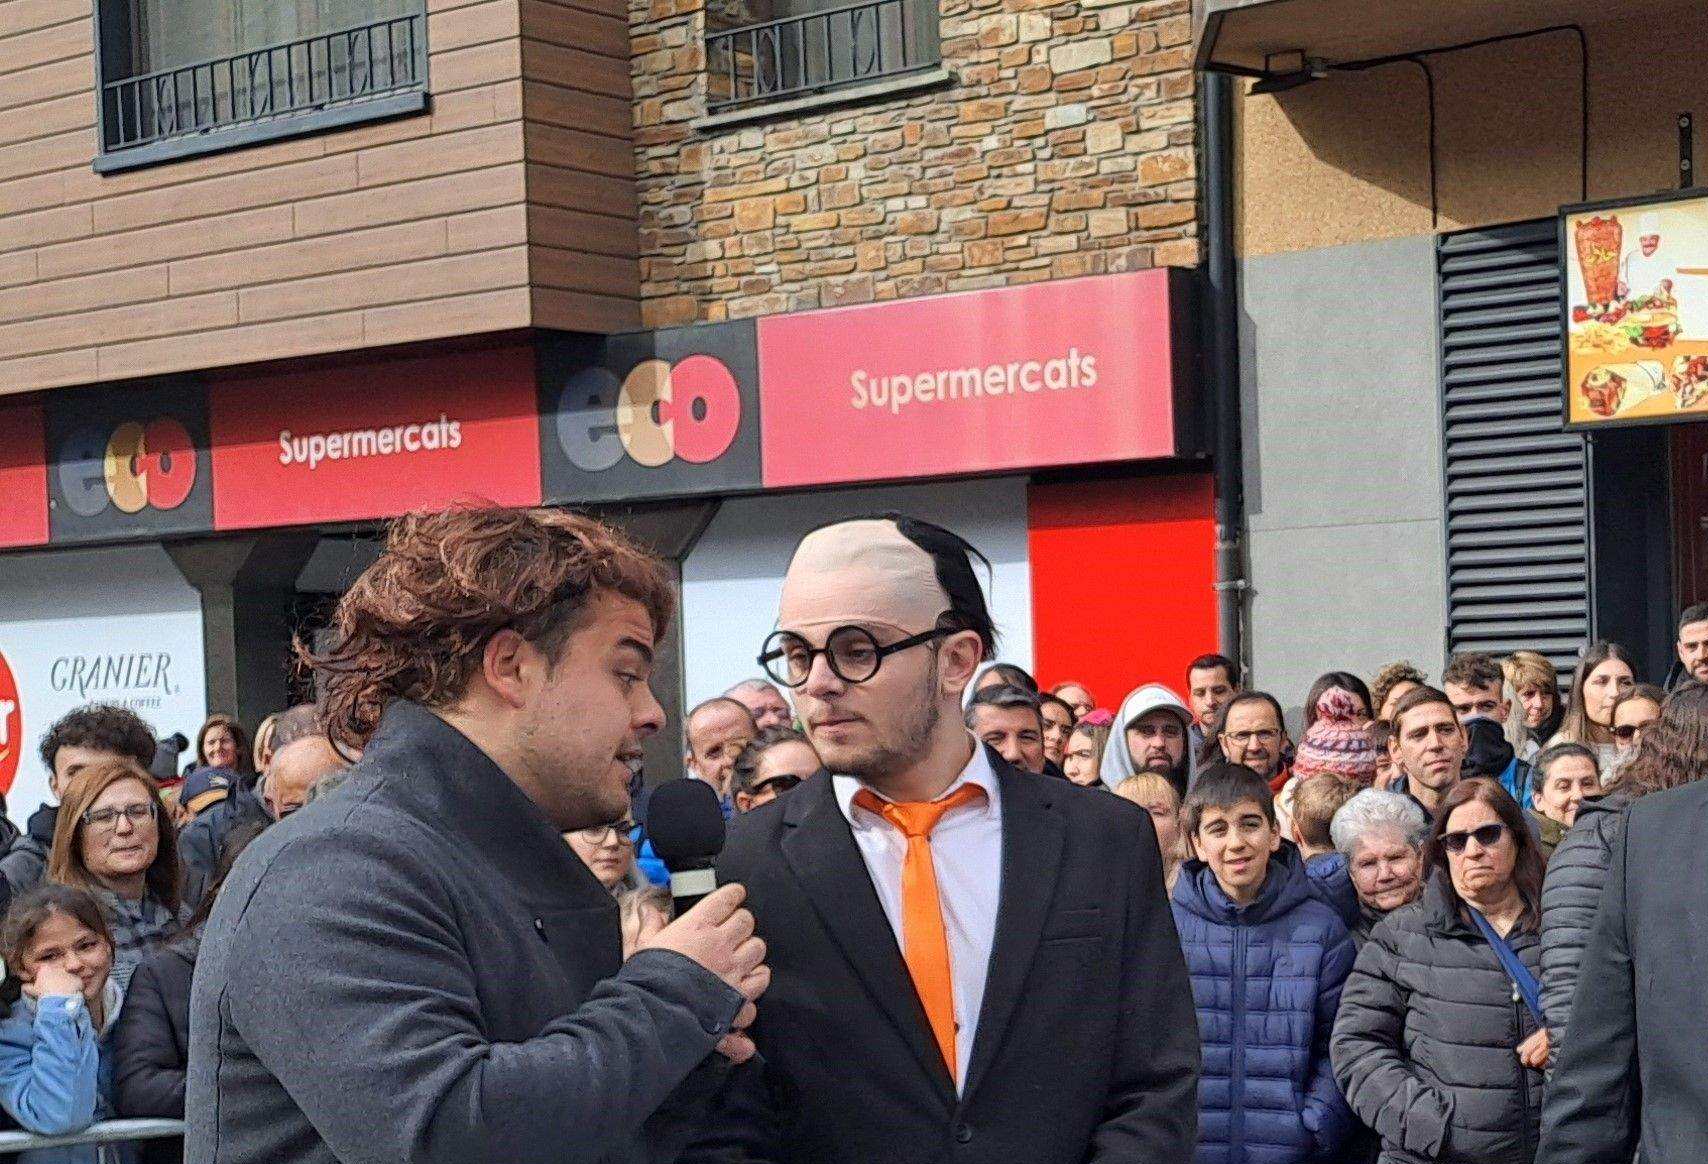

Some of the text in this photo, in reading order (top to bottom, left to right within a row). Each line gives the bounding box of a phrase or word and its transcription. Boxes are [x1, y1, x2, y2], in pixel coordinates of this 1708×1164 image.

[850, 346, 1097, 415] Supermercats
[279, 412, 462, 471] Supermercats
[51, 651, 172, 699] GRANIER
